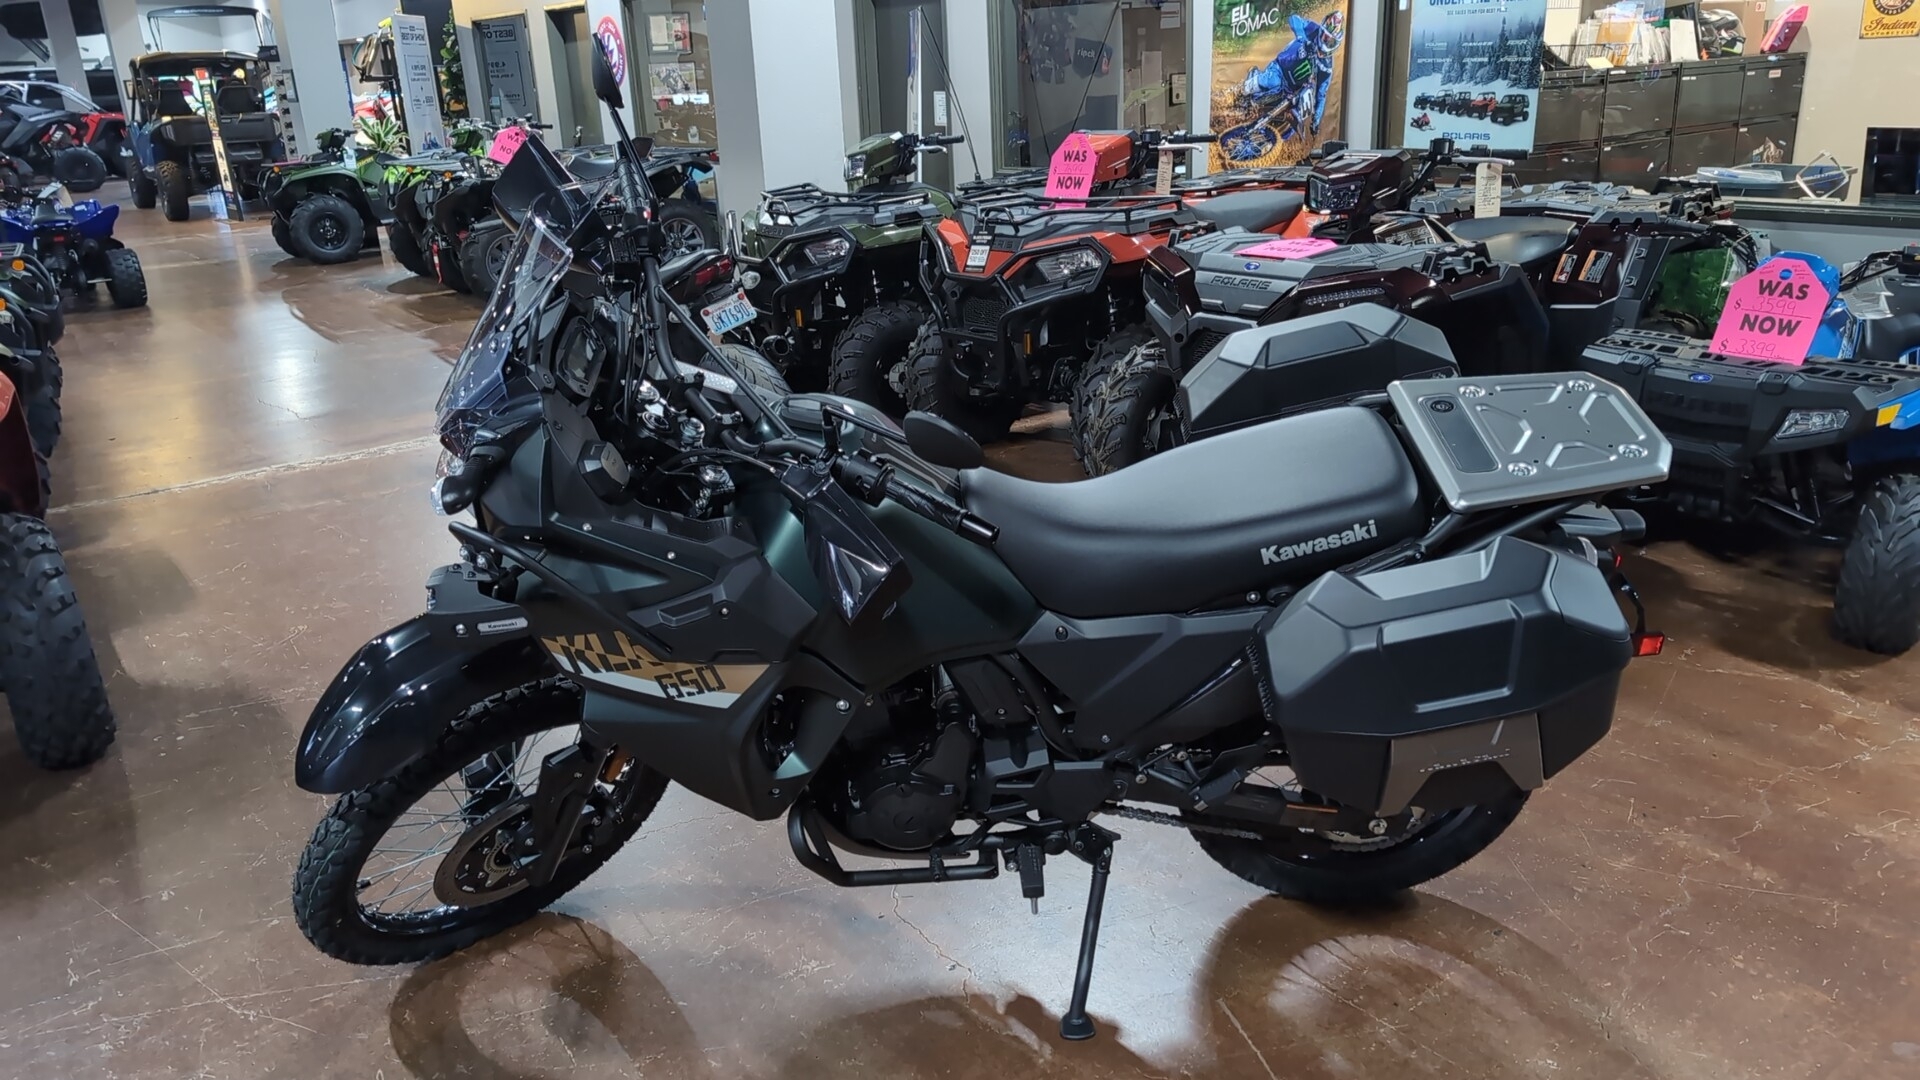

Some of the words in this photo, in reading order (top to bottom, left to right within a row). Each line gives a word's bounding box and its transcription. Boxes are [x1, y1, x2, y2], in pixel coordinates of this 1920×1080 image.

[1232, 3, 1250, 22] ELI
[1231, 8, 1279, 38] TOMAC
[1864, 17, 1917, 31] Indian
[1442, 132, 1491, 141] POLARIS
[499, 145, 516, 156] NO
[1063, 150, 1087, 163] WAS
[1056, 176, 1085, 190] NOW
[1210, 275, 1272, 290] POLARIS
[1758, 279, 1810, 300] WAS
[1734, 298, 1742, 310] $
[1739, 314, 1802, 337] NOW
[1718, 338, 1728, 353] $
[1260, 519, 1378, 565] Kawasaki
[487, 621, 518, 629] Kawasaki
[654, 664, 727, 700] 650
